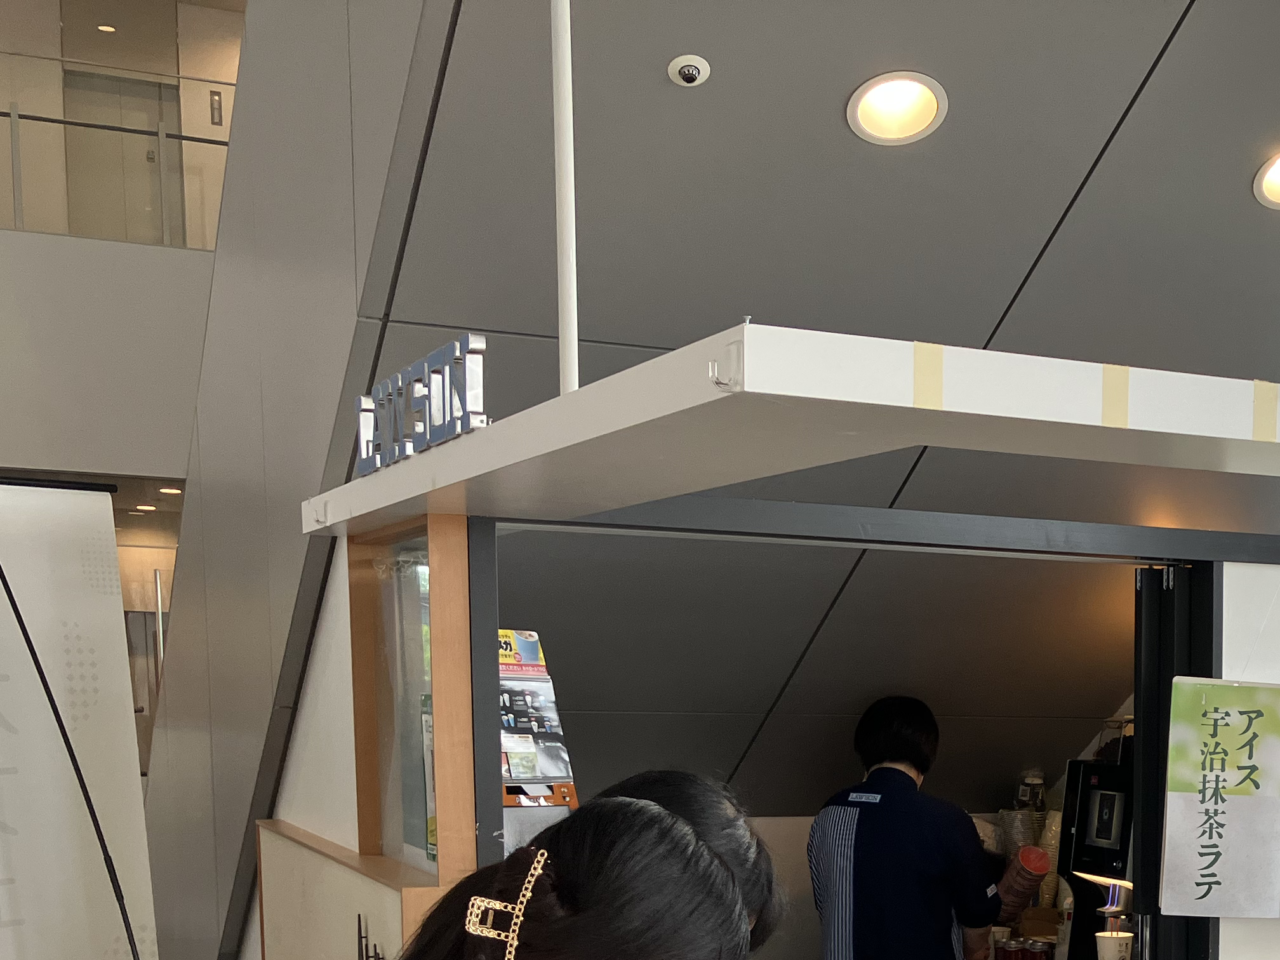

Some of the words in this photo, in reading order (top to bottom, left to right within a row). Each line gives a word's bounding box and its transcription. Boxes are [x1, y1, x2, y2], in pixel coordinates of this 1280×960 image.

[355, 333, 487, 476] LAWSON
[1194, 707, 1232, 900] 宇治抹茶ラテ
[1234, 709, 1264, 790] アイス
